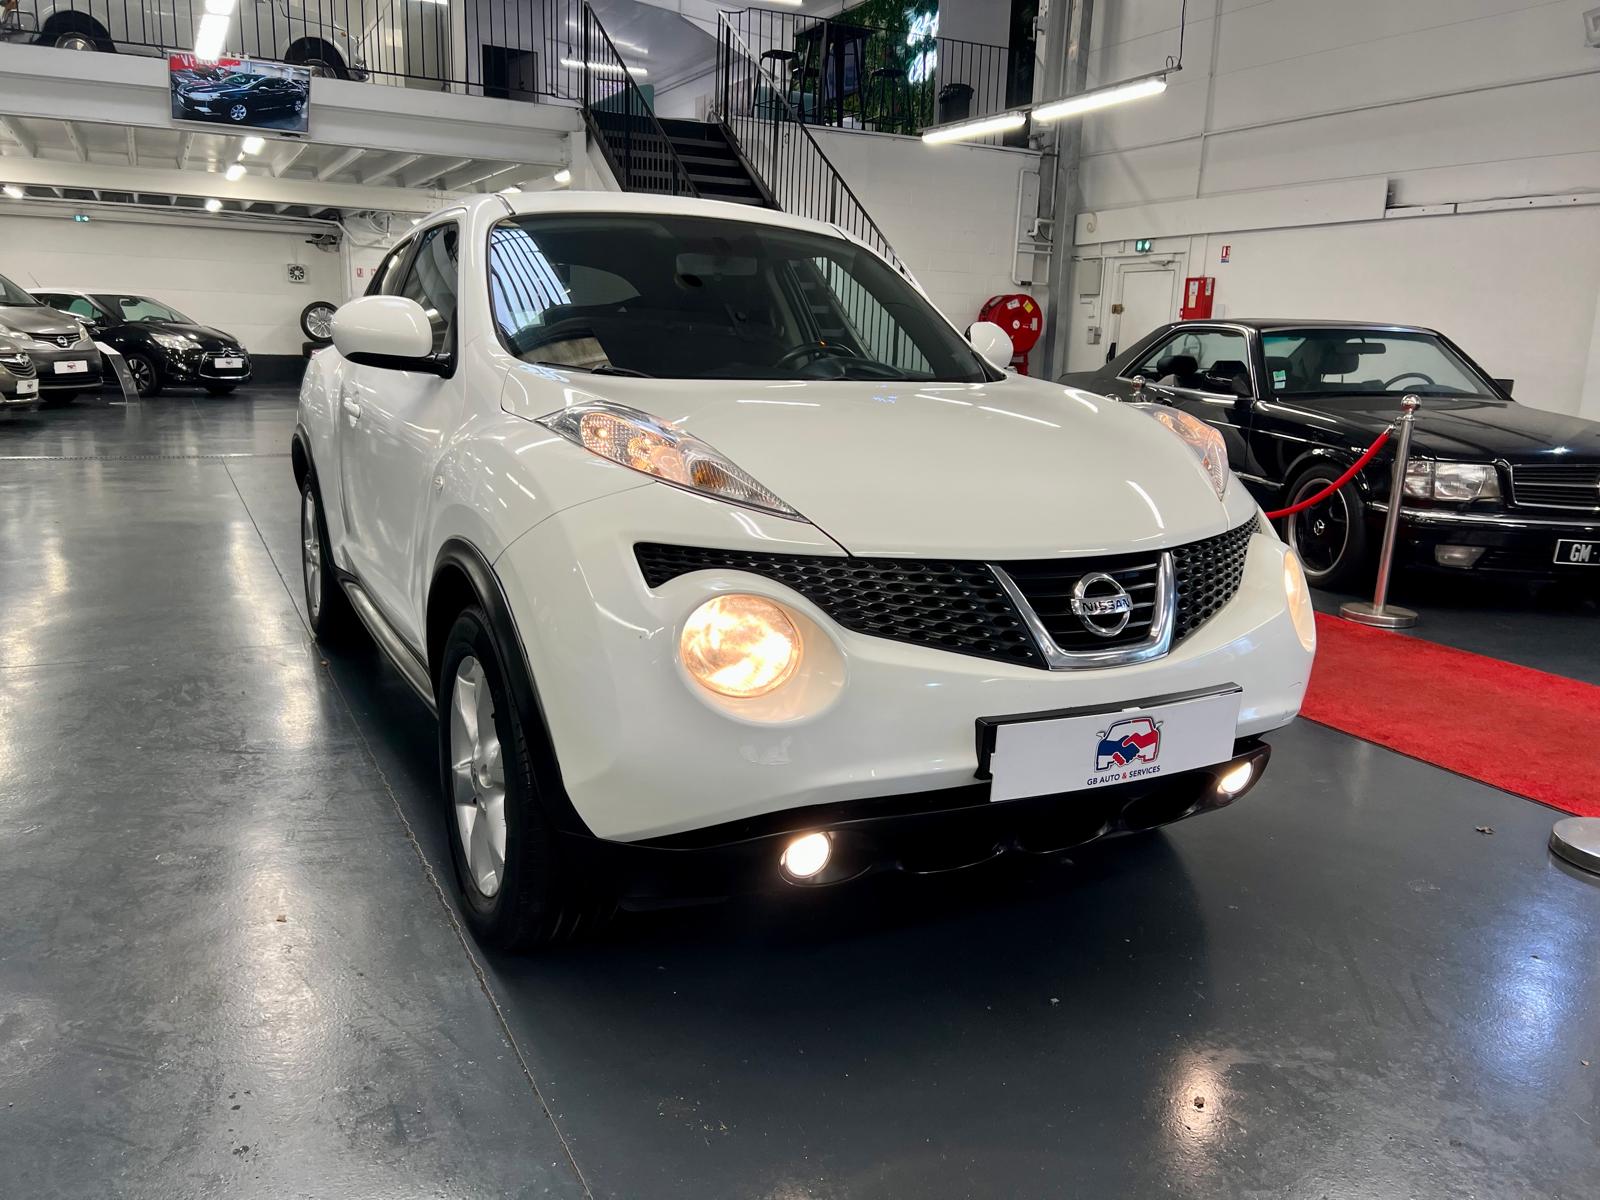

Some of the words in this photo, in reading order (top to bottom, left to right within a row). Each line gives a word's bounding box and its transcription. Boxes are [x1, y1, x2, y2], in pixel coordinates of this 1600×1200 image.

[1082, 599, 1130, 612] NISSAN
[1087, 778, 1098, 786] GB
[1099, 774, 1121, 784] AUTO
[1122, 772, 1127, 780] &
[1129, 765, 1161, 779] SERVICES
